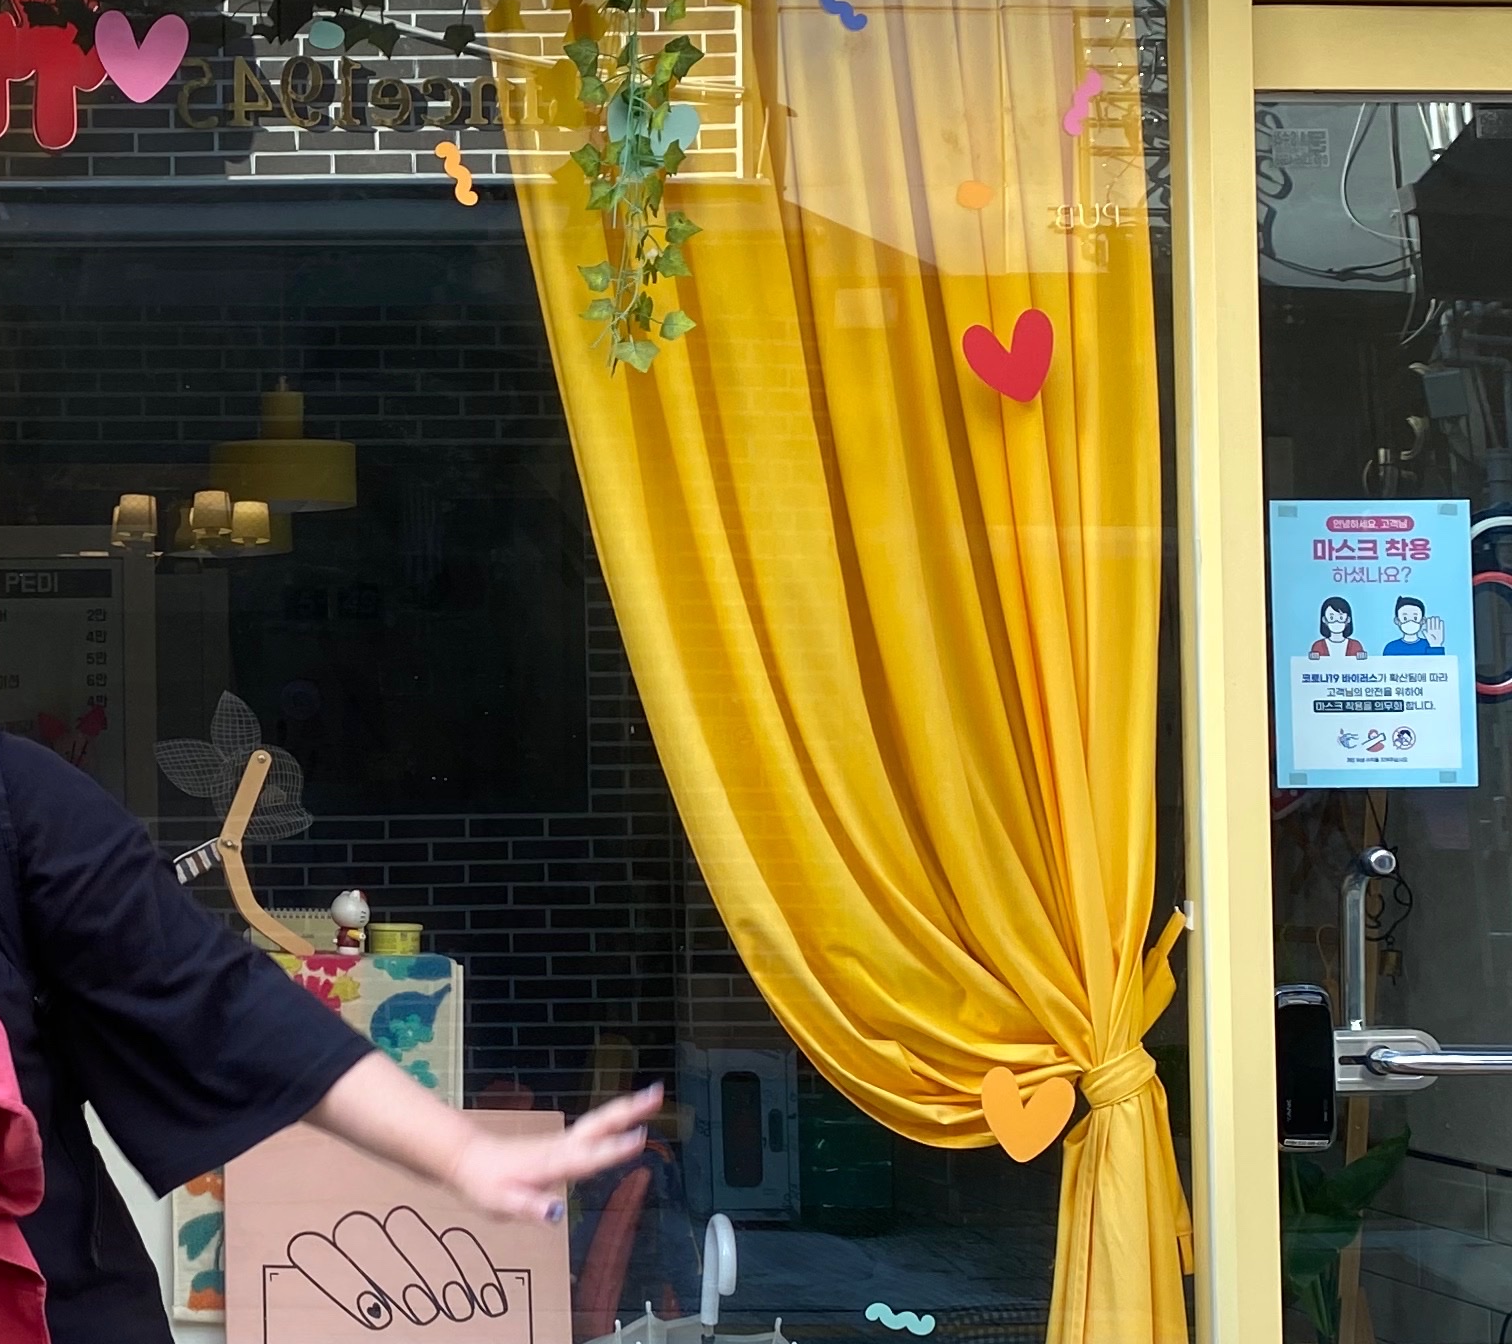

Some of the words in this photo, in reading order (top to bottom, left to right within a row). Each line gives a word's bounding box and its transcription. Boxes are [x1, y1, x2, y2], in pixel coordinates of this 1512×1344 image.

[1381, 518, 1408, 529] 고객님
[1312, 538, 1379, 562] 마스크
[1385, 537, 1432, 562] 착용
[1332, 566, 1412, 584] 하셨나요?
[5, 572, 58, 593] PEDI
[86, 630, 108, 644] 4만
[86, 652, 108, 665] 5만
[86, 674, 108, 687] 6만
[1301, 673, 1339, 683] 코로나19
[1342, 673, 1387, 683] 바이러스가
[1429, 672, 1449, 683] 따라
[1326, 687, 1363, 698] 고객님의
[1365, 687, 1392, 697] 안전을
[1395, 687, 1424, 697] 위하여
[1315, 701, 1343, 711] 마스크
